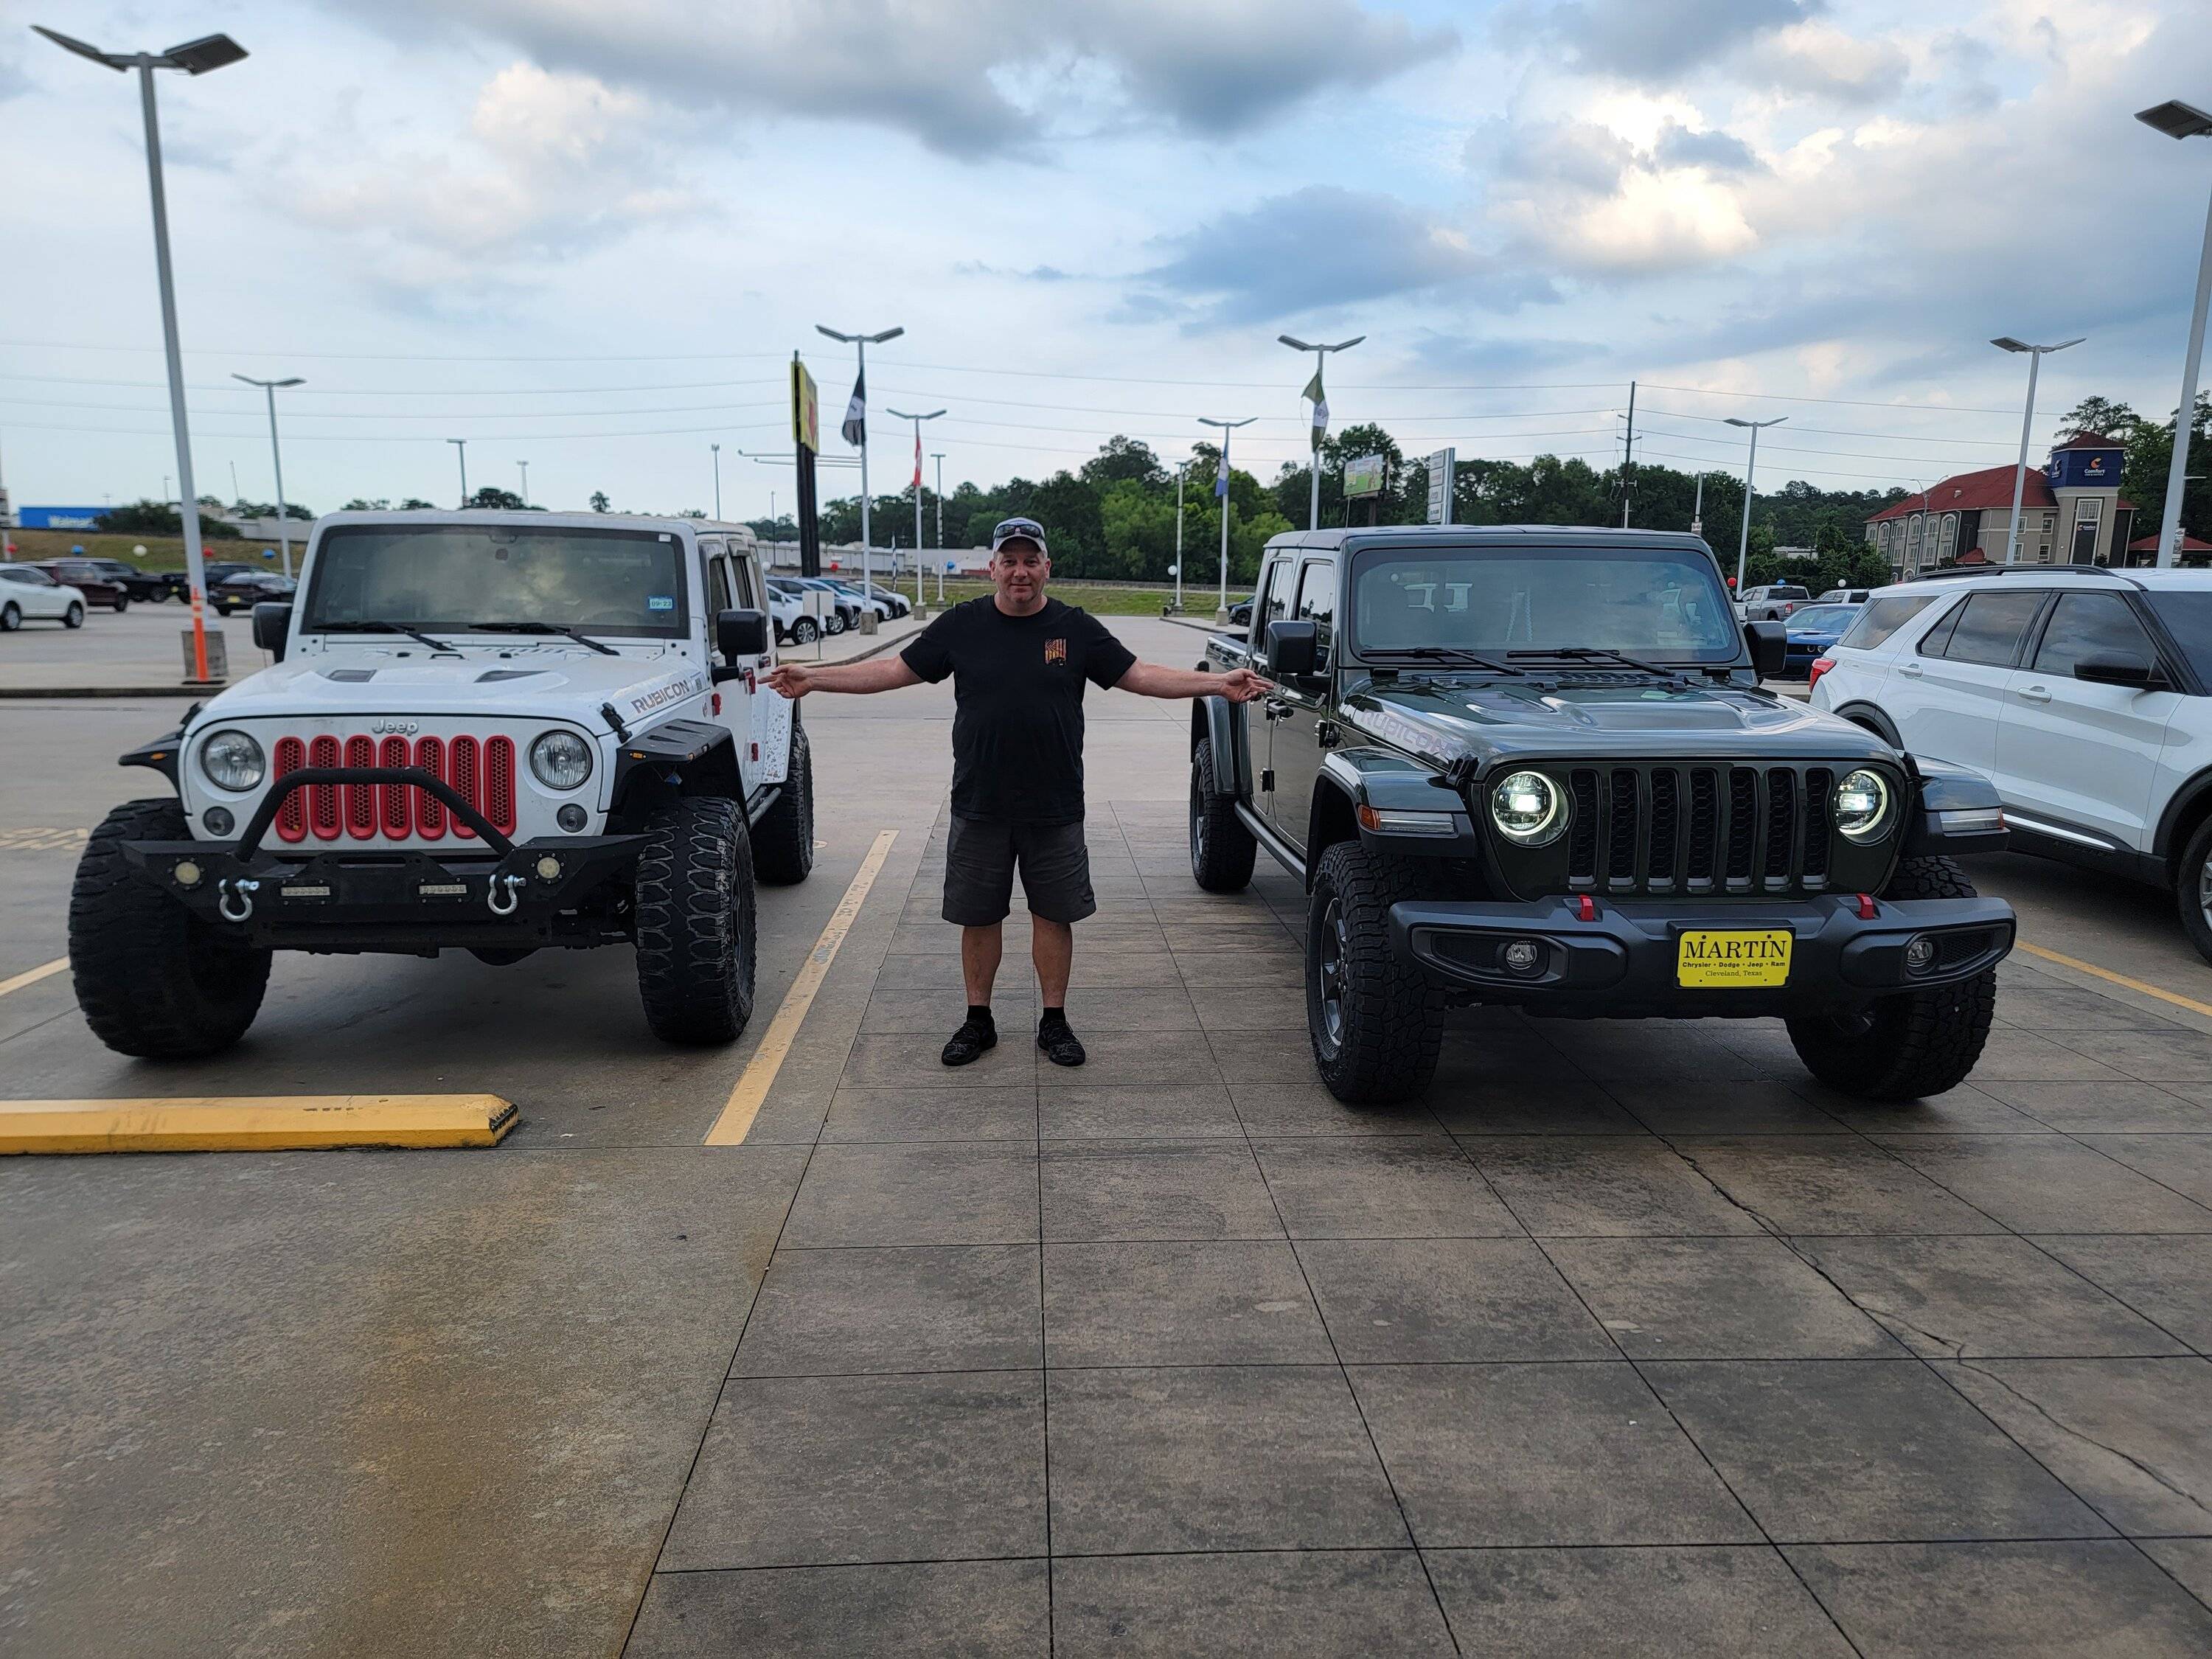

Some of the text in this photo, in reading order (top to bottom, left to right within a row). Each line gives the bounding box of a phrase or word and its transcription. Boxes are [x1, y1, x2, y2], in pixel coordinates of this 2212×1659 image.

[630, 679, 690, 714] RUBICON
[371, 719, 419, 737] Jeep
[1360, 708, 1454, 757] RUBICON
[1683, 940, 1788, 959] MARTIN
